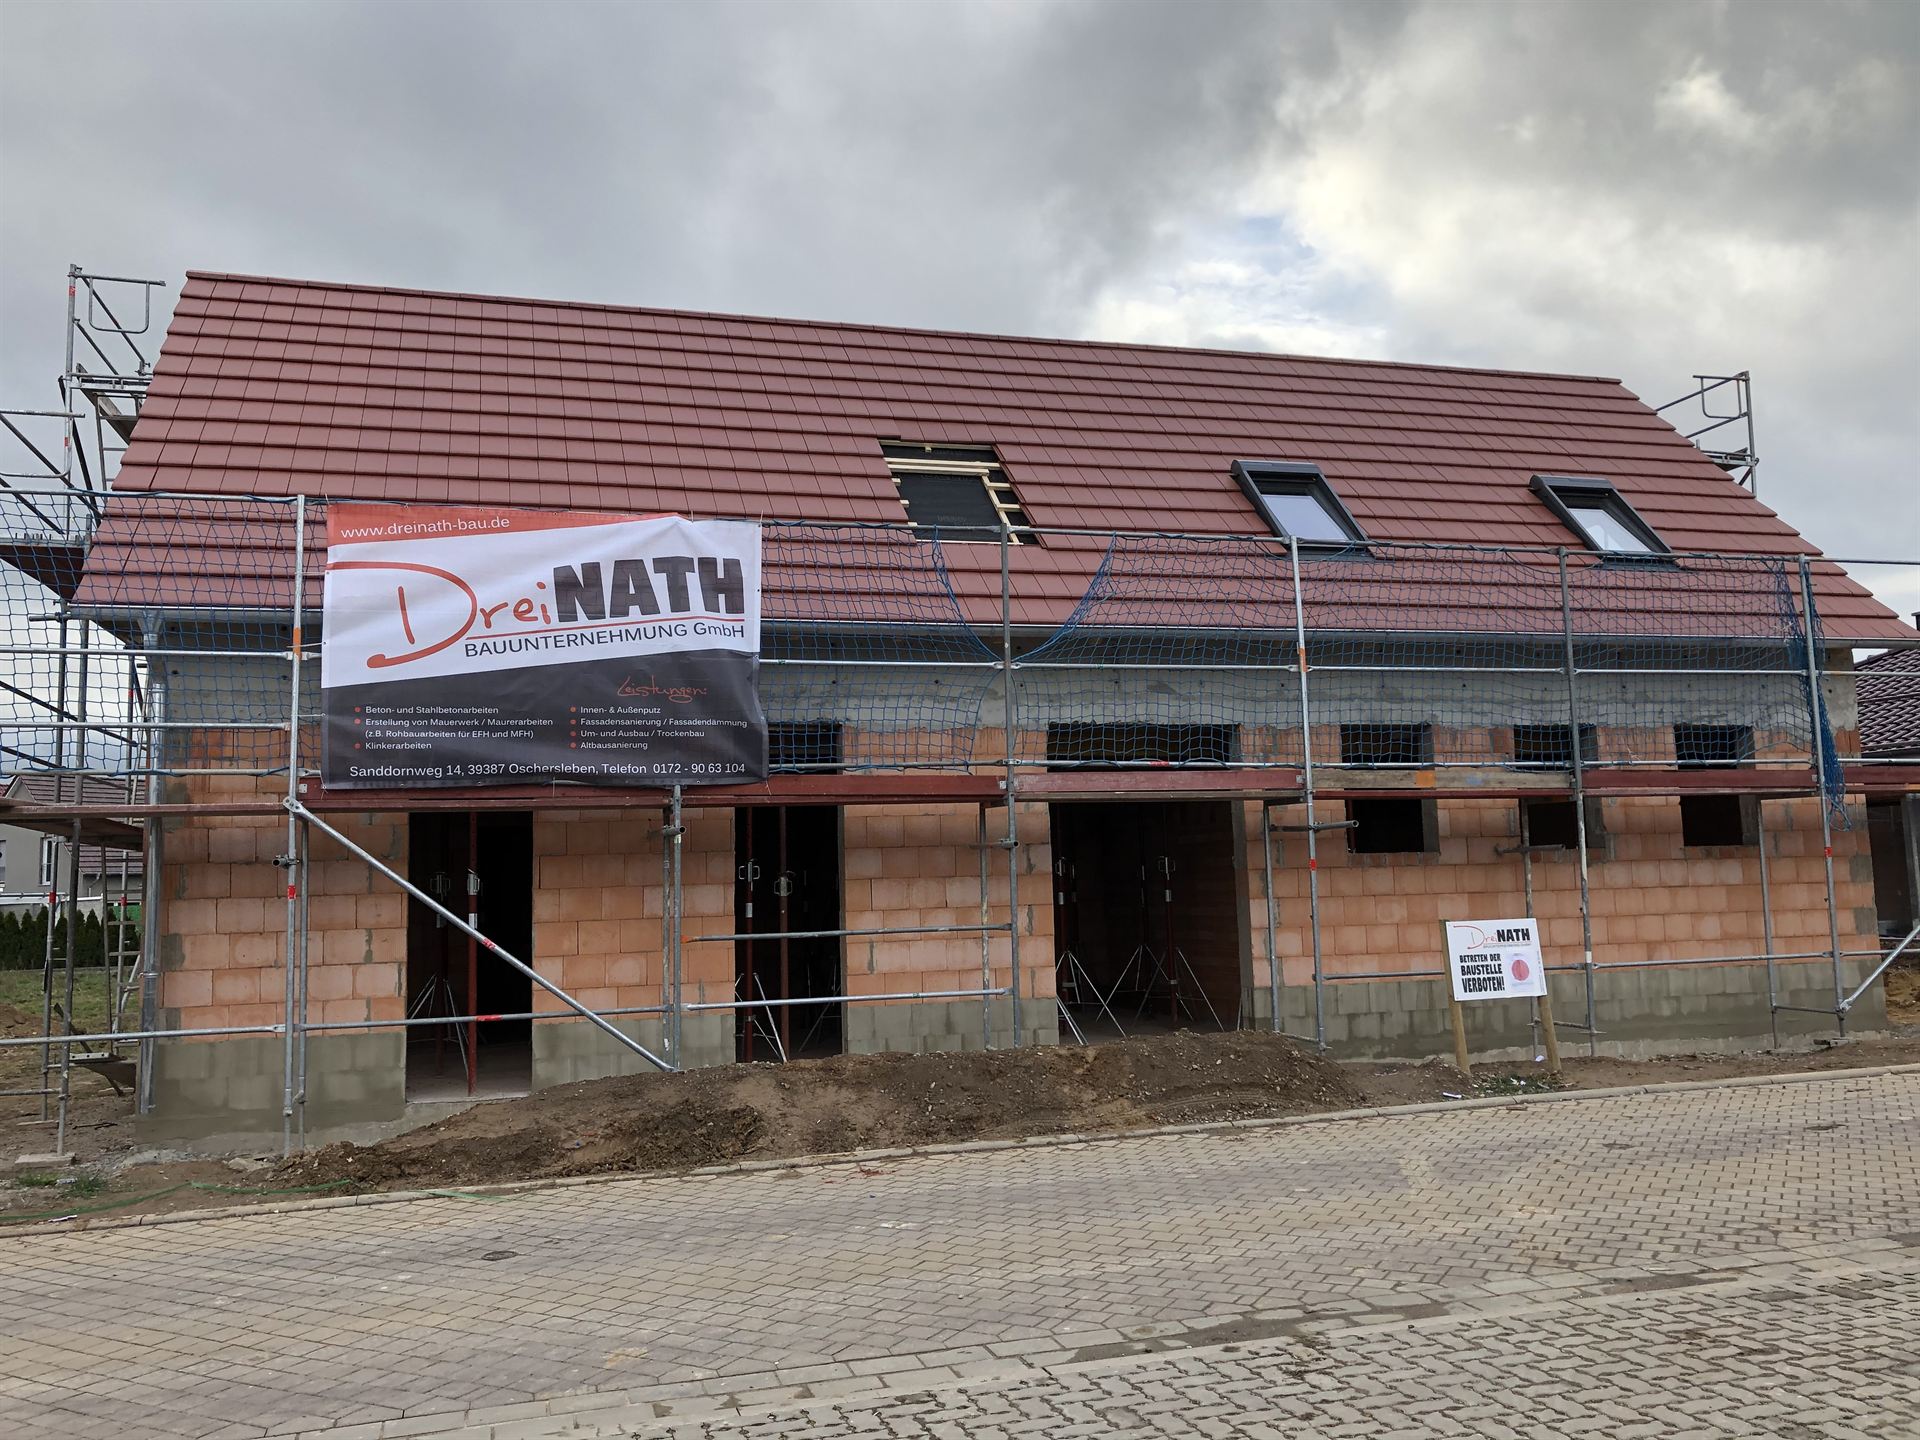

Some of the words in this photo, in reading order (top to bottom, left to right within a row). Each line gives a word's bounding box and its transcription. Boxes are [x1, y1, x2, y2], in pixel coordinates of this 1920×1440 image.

[340, 516, 511, 539] www.dreinath-bau.de
[464, 623, 688, 658] BAUUNTERNEHMUNG
[692, 622, 745, 639] GmbH
[616, 675, 708, 704] Leistungen:
[365, 706, 395, 714] Beton-
[396, 706, 414, 714] und
[415, 706, 499, 714] Stahlbetonarbeiten
[580, 706, 607, 714] Innen-
[609, 706, 616, 714] &
[616, 706, 661, 716] Außenputz
[365, 718, 410, 727] Erstellung
[430, 718, 480, 726] Mauerwerk
[487, 717, 554, 726] Maurerarbeiten
[580, 718, 662, 727] Fassadensanierung
[365, 730, 384, 739] (z.B.
[385, 730, 456, 738] Rohbauarbeiten
[457, 730, 471, 738] für
[471, 730, 490, 738] EFH
[491, 730, 509, 738] und
[510, 730, 534, 739] MFH)
[656, 730, 705, 738] Trockenbau
[365, 742, 432, 750] Klinkerarbeiten
[580, 741, 648, 750] Altbausanierung
[350, 765, 443, 779] Sanddornweg
[446, 764, 465, 777] 14,
[467, 763, 505, 775] 39387
[508, 762, 599, 775] Oschersleben,
[601, 763, 647, 774] Telefon
[652, 763, 682, 774] 0172
[691, 763, 706, 774] 90
[707, 763, 722, 774] 63
[724, 763, 746, 773] 104
[1459, 954, 1488, 963] BETRETEN
[1489, 953, 1501, 962] DER
[1460, 963, 1503, 976] BAUSTELLE
[1461, 976, 1506, 993] VERBOTEN!
